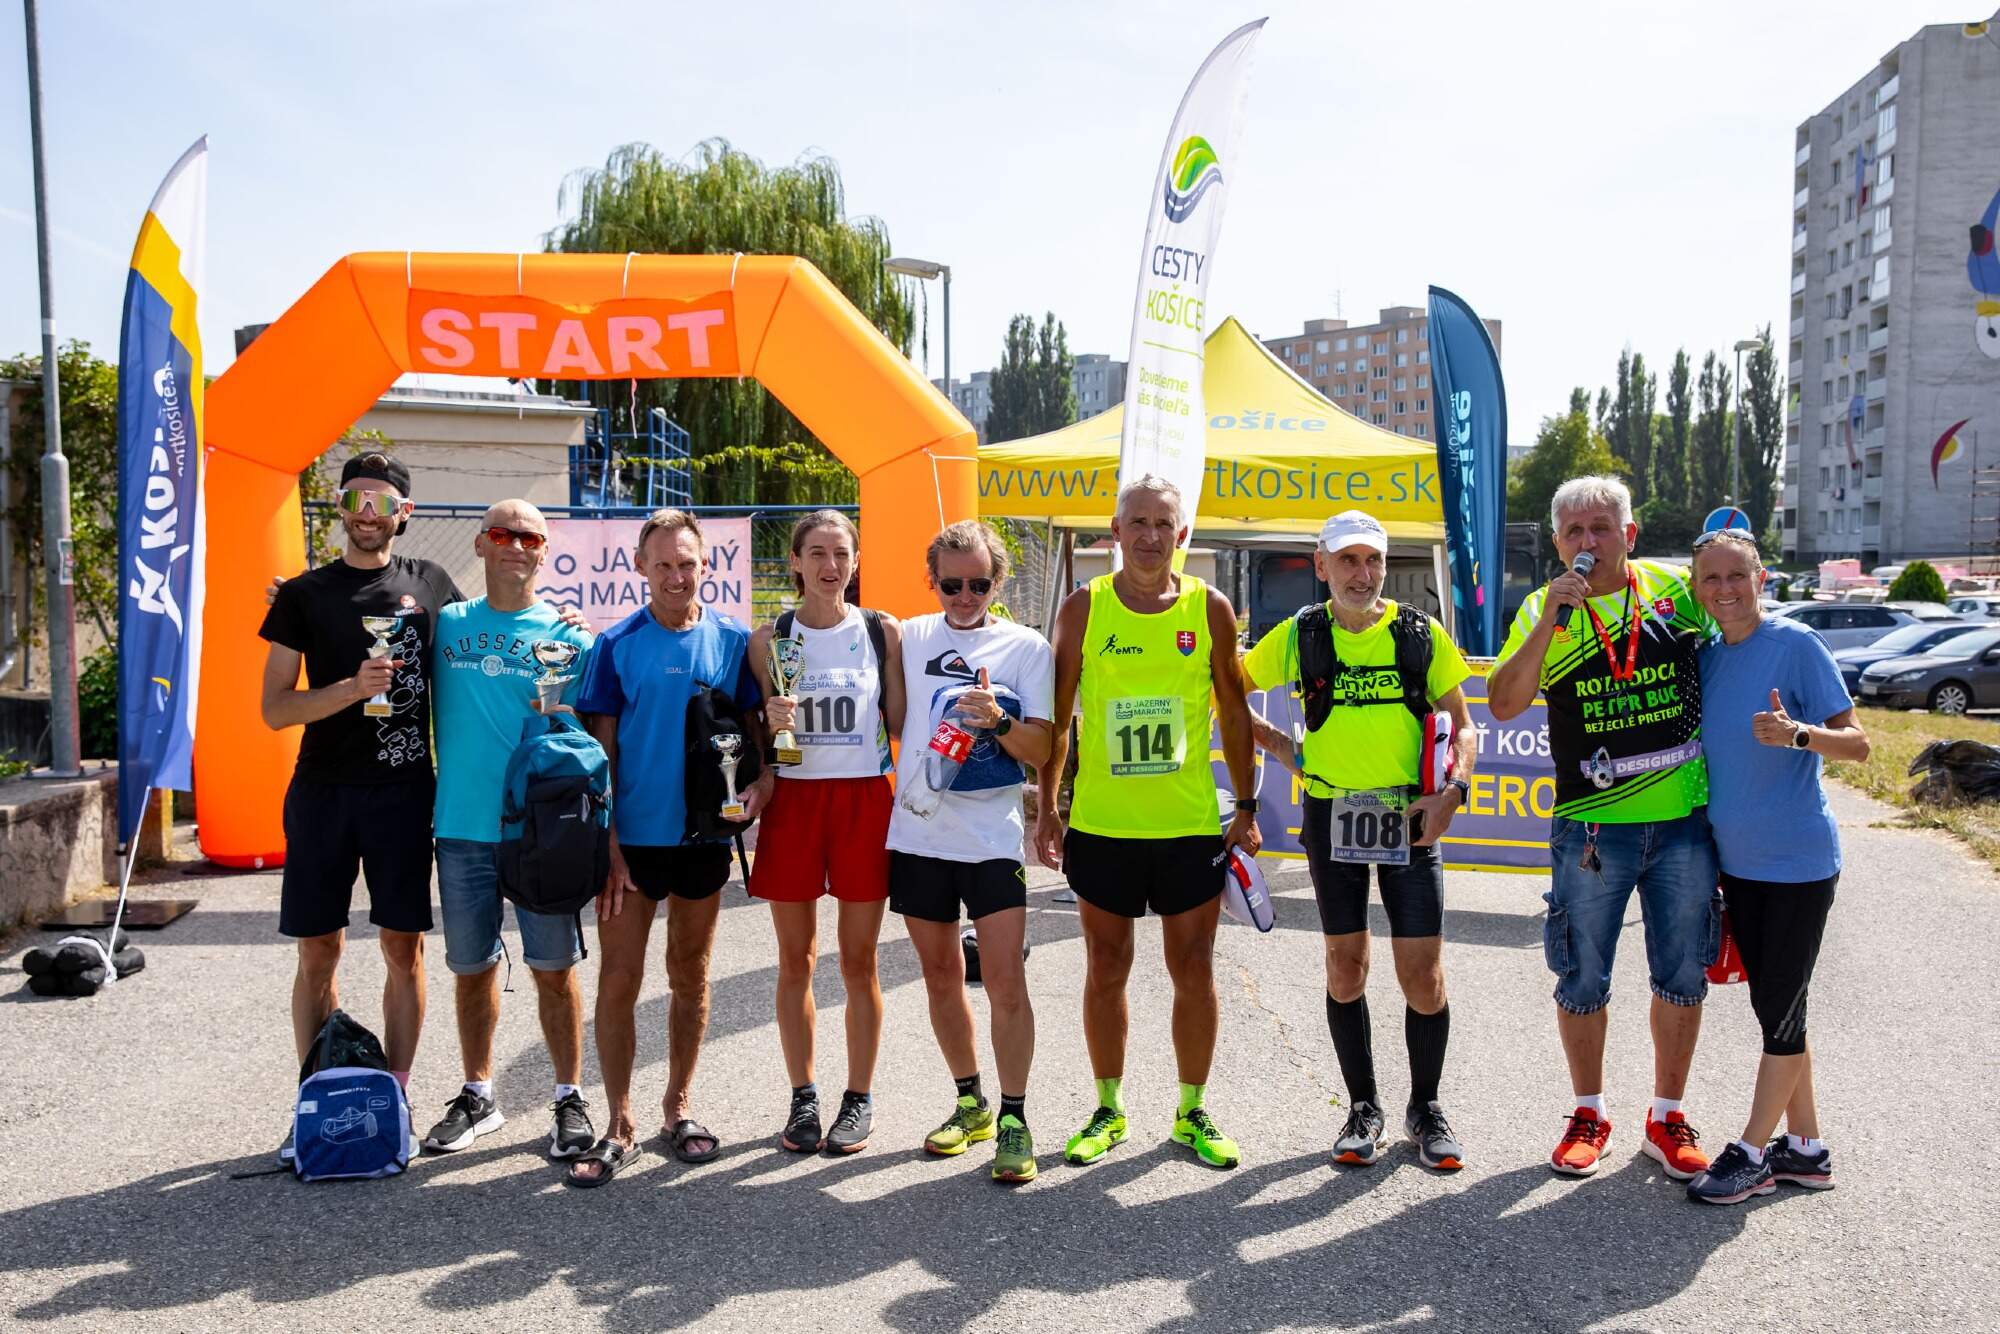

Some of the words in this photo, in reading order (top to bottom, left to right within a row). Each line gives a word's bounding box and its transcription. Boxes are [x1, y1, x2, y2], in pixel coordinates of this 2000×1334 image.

[1152, 245, 1205, 285] CESTY
[1146, 283, 1204, 332] KOŠICE
[420, 308, 725, 374] START
[1209, 410, 1327, 432] ošice
[978, 460, 1437, 503] www.tkosice.sk
[591, 539, 740, 573] JANÝ
[590, 575, 742, 605] MARÓN
[442, 632, 546, 676] RUSSELL
[798, 696, 856, 733] 110
[1133, 707, 1172, 715] MARATÓN
[1583, 694, 1642, 719] PETER
[1637, 703, 1684, 725] PRETEKY
[1115, 724, 1174, 762] 114
[1497, 724, 1552, 757] KOŠ
[1456, 774, 1557, 819] ERO
[1338, 811, 1402, 849] 108
